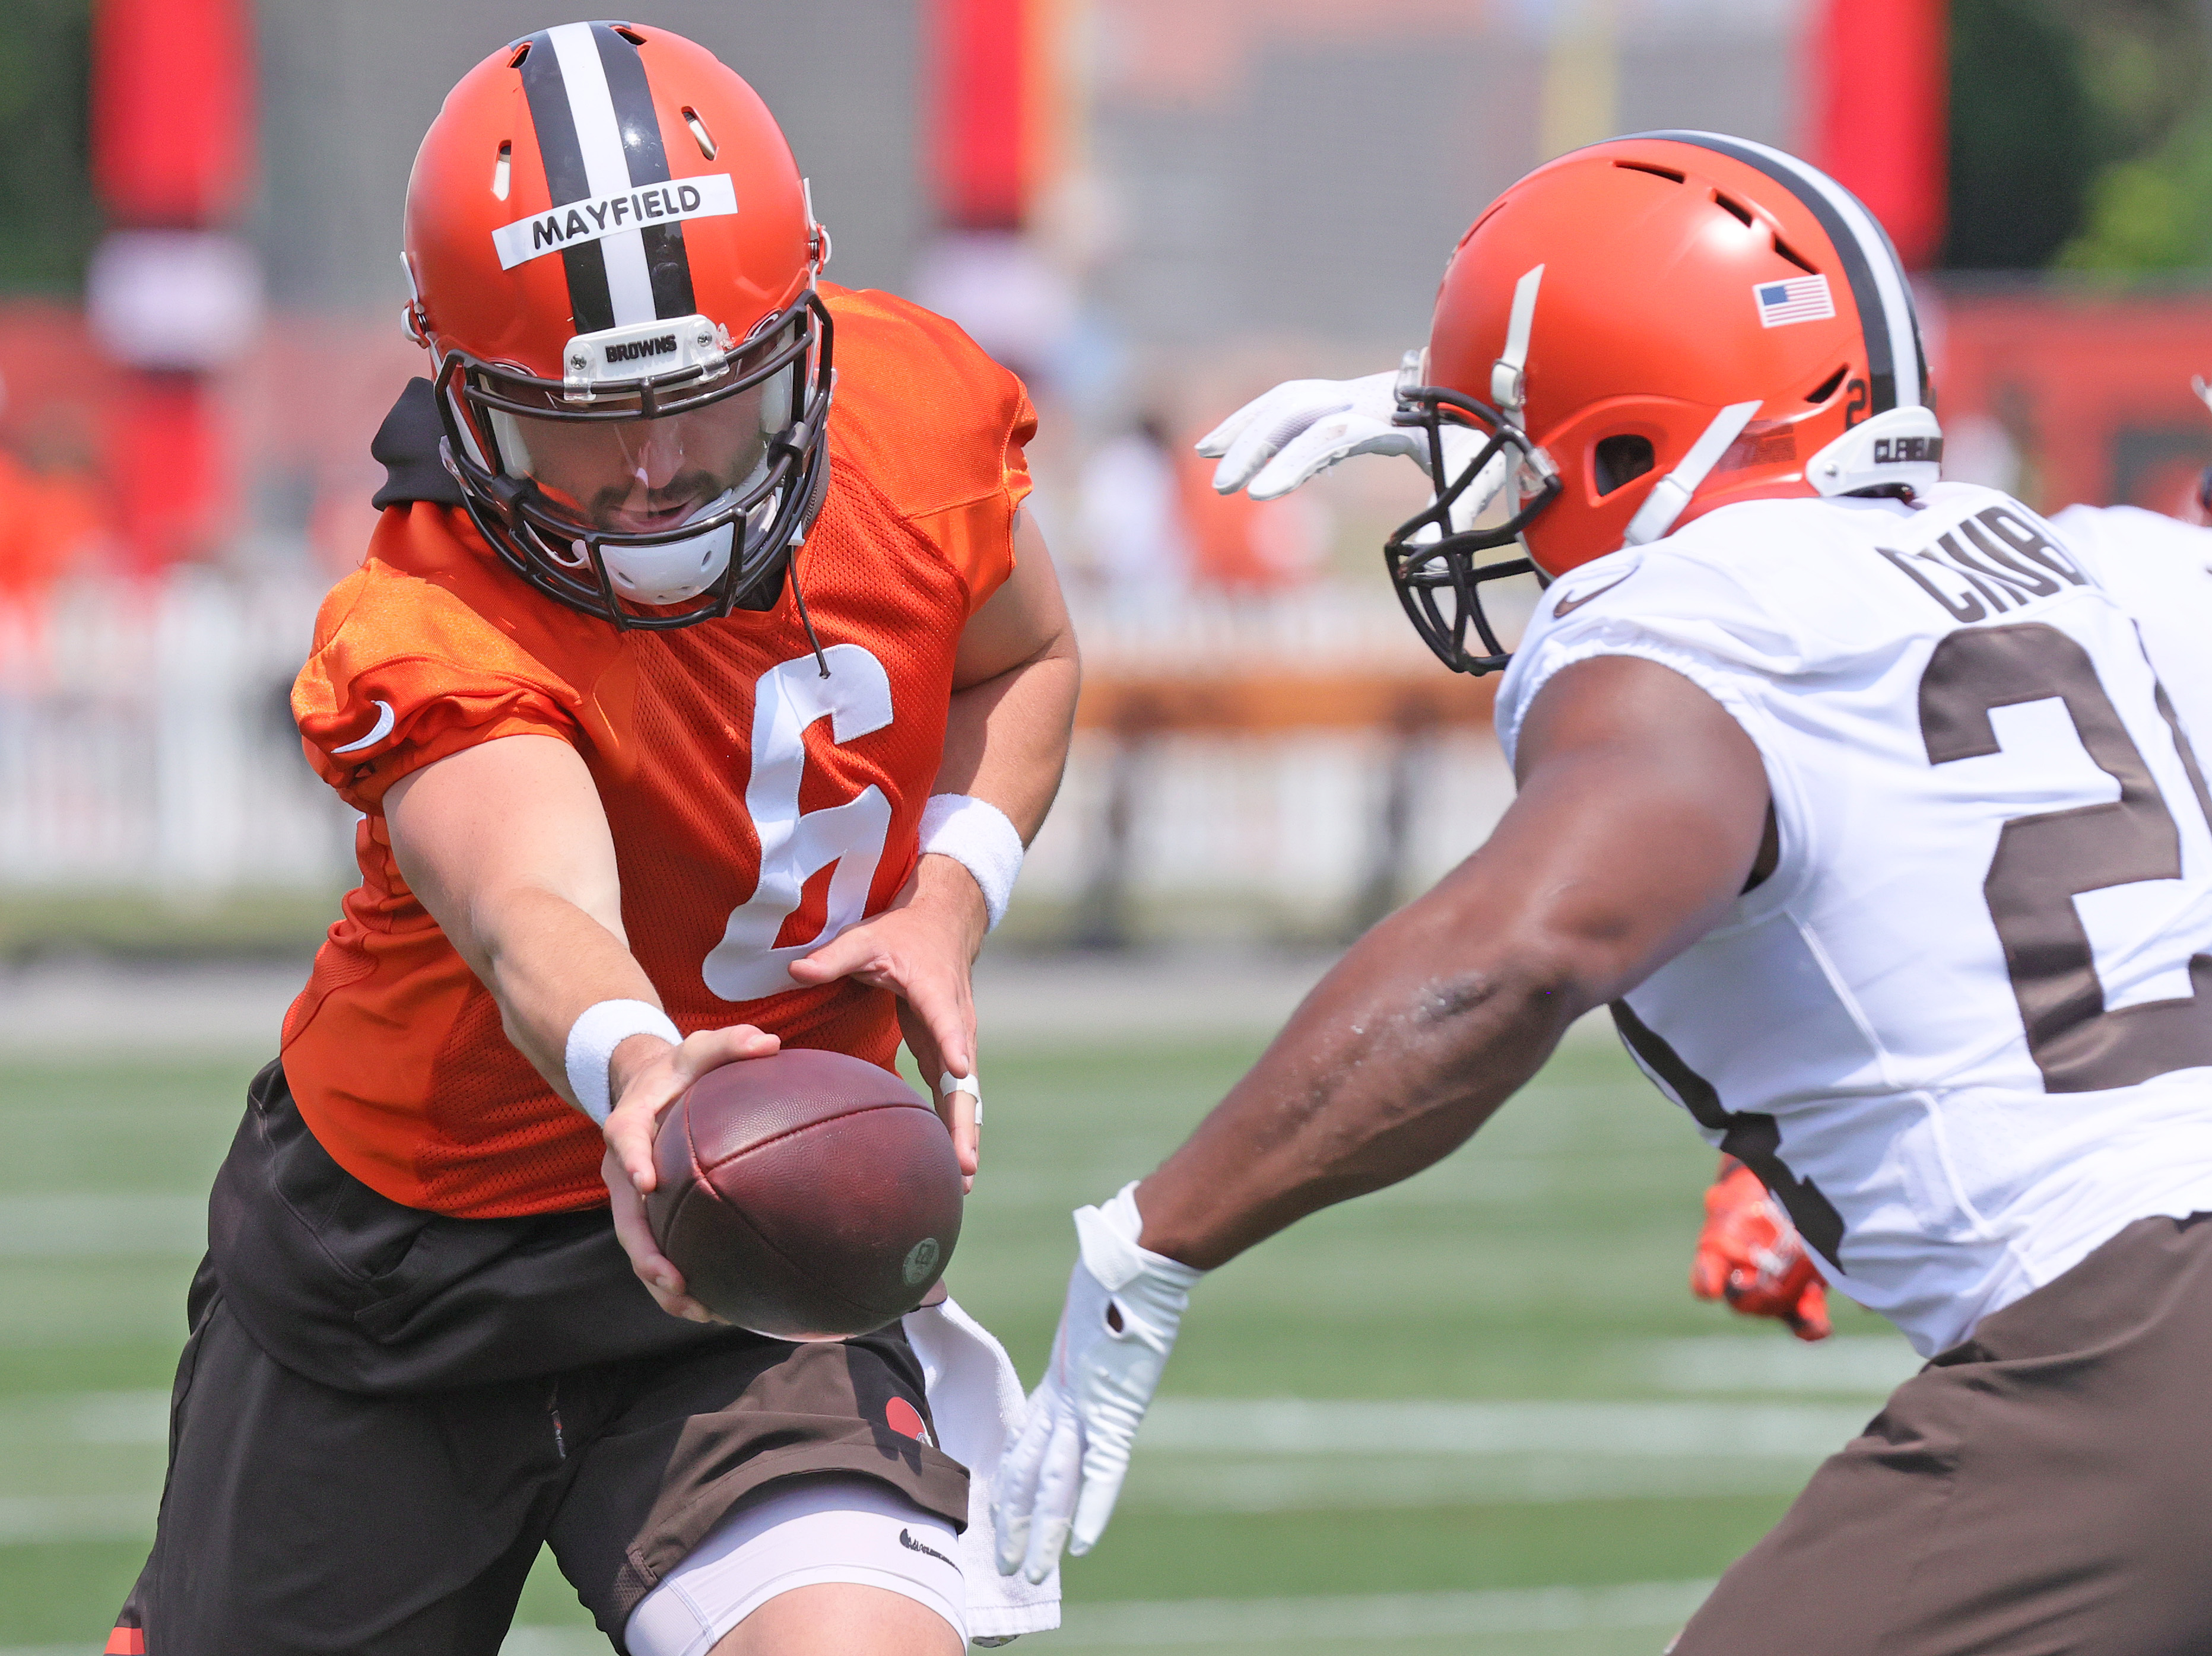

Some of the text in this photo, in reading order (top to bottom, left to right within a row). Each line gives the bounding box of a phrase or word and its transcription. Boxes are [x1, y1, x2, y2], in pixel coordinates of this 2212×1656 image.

[533, 185, 700, 250] MAYFIELD
[605, 333, 677, 363] BROWNS
[702, 643, 893, 1002] 6
